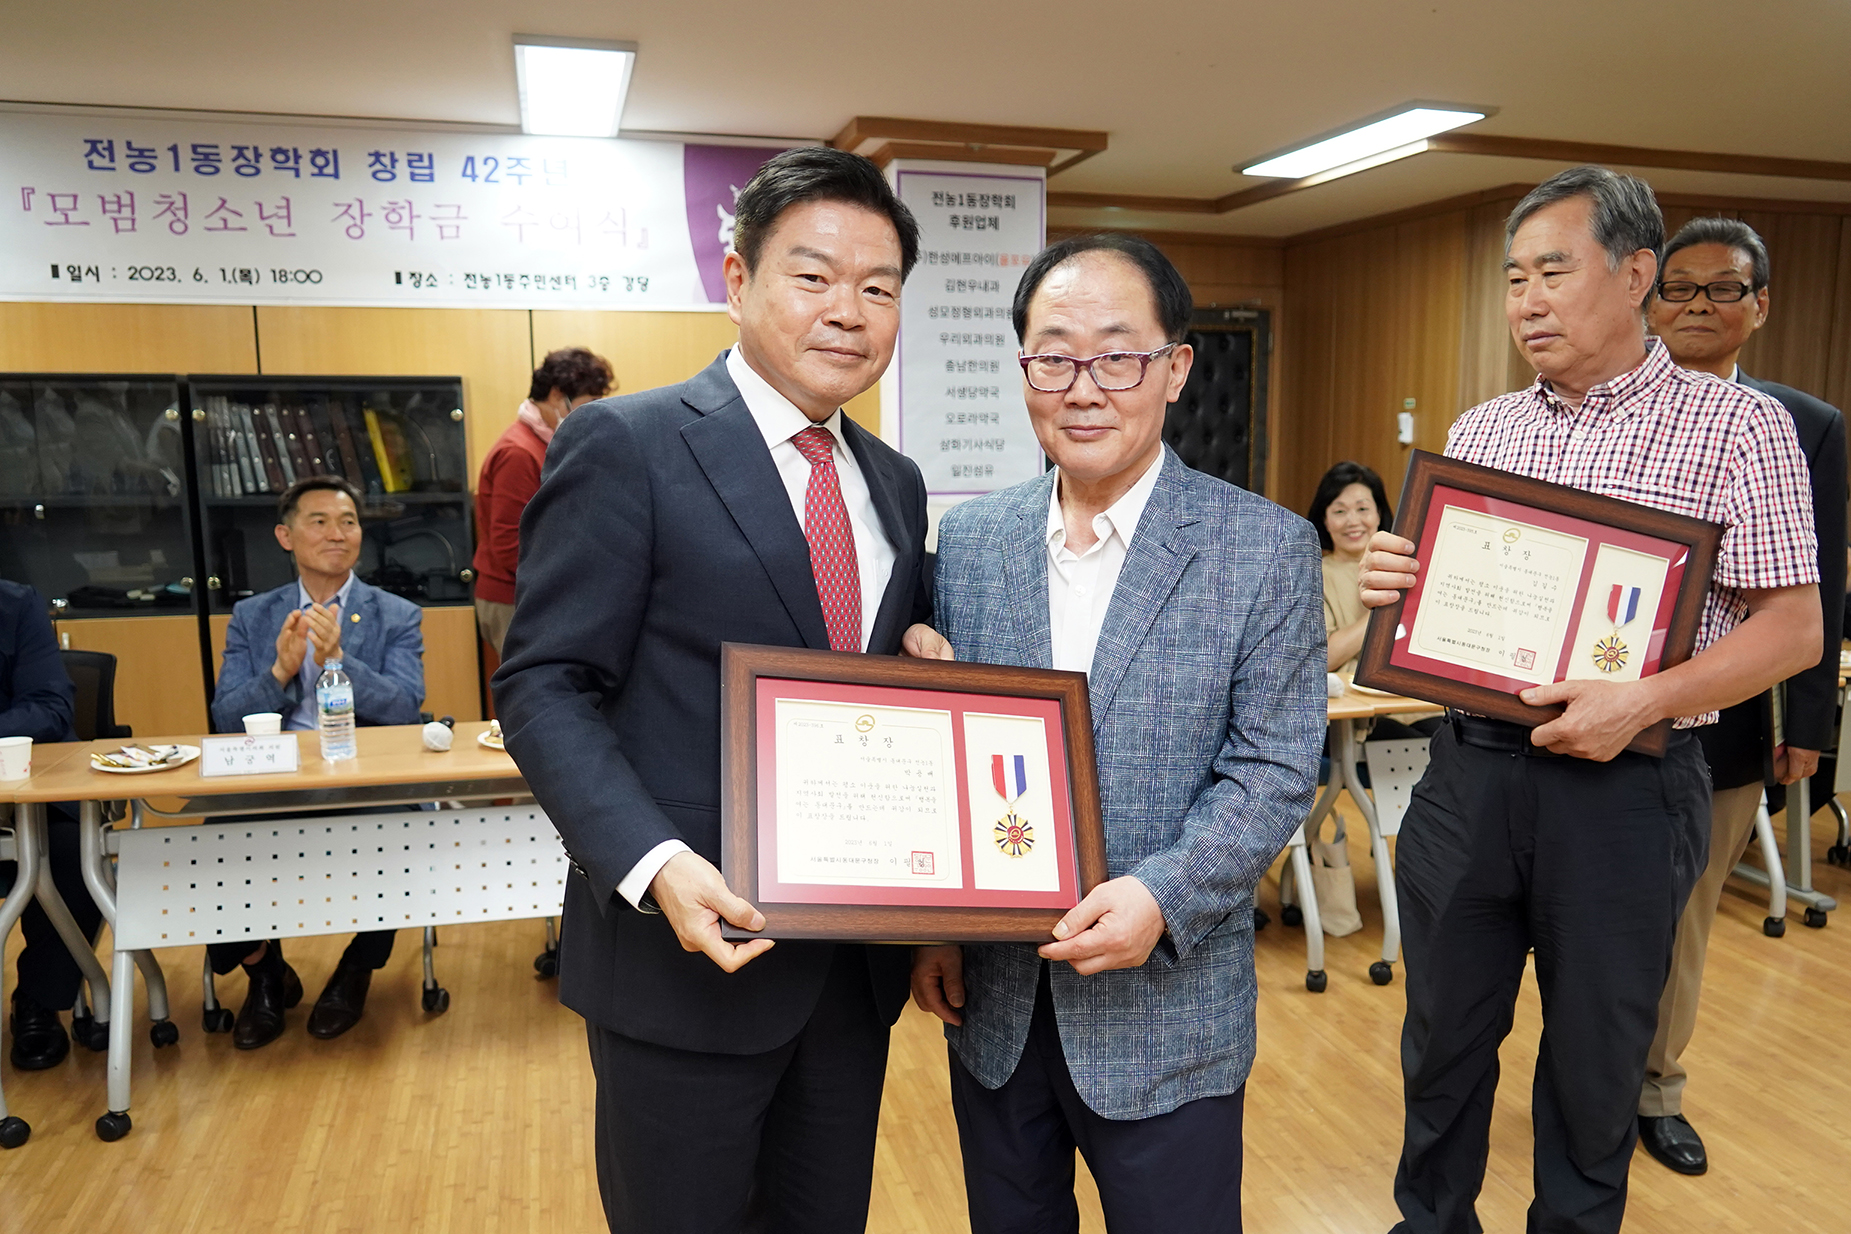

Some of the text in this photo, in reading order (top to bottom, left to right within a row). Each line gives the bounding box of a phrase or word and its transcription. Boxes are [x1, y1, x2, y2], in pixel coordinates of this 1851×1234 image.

[83, 138, 569, 187] 전농1동장학회 창립 42주년
[931, 190, 1016, 209] 전농1동장학회
[21, 186, 296, 238] 『모범청소년
[331, 198, 468, 241] 장학금
[950, 214, 1000, 231] 후원업체
[66, 264, 101, 284] 일시
[127, 265, 182, 284] 2023.
[192, 267, 209, 284] 6.
[269, 269, 323, 284] 18:00
[408, 271, 439, 289] 장소
[464, 272, 577, 291] 전농1동주민센터
[588, 276, 610, 292] 3층
[945, 279, 1000, 293] 김현우내과
[939, 331, 1005, 347] 우리외과의원
[945, 359, 1000, 373] 충남한의원
[945, 411, 1000, 425] 오로라약국
[939, 437, 1005, 452] 삼화기사식당
[951, 463, 994, 478] 일진섬유
